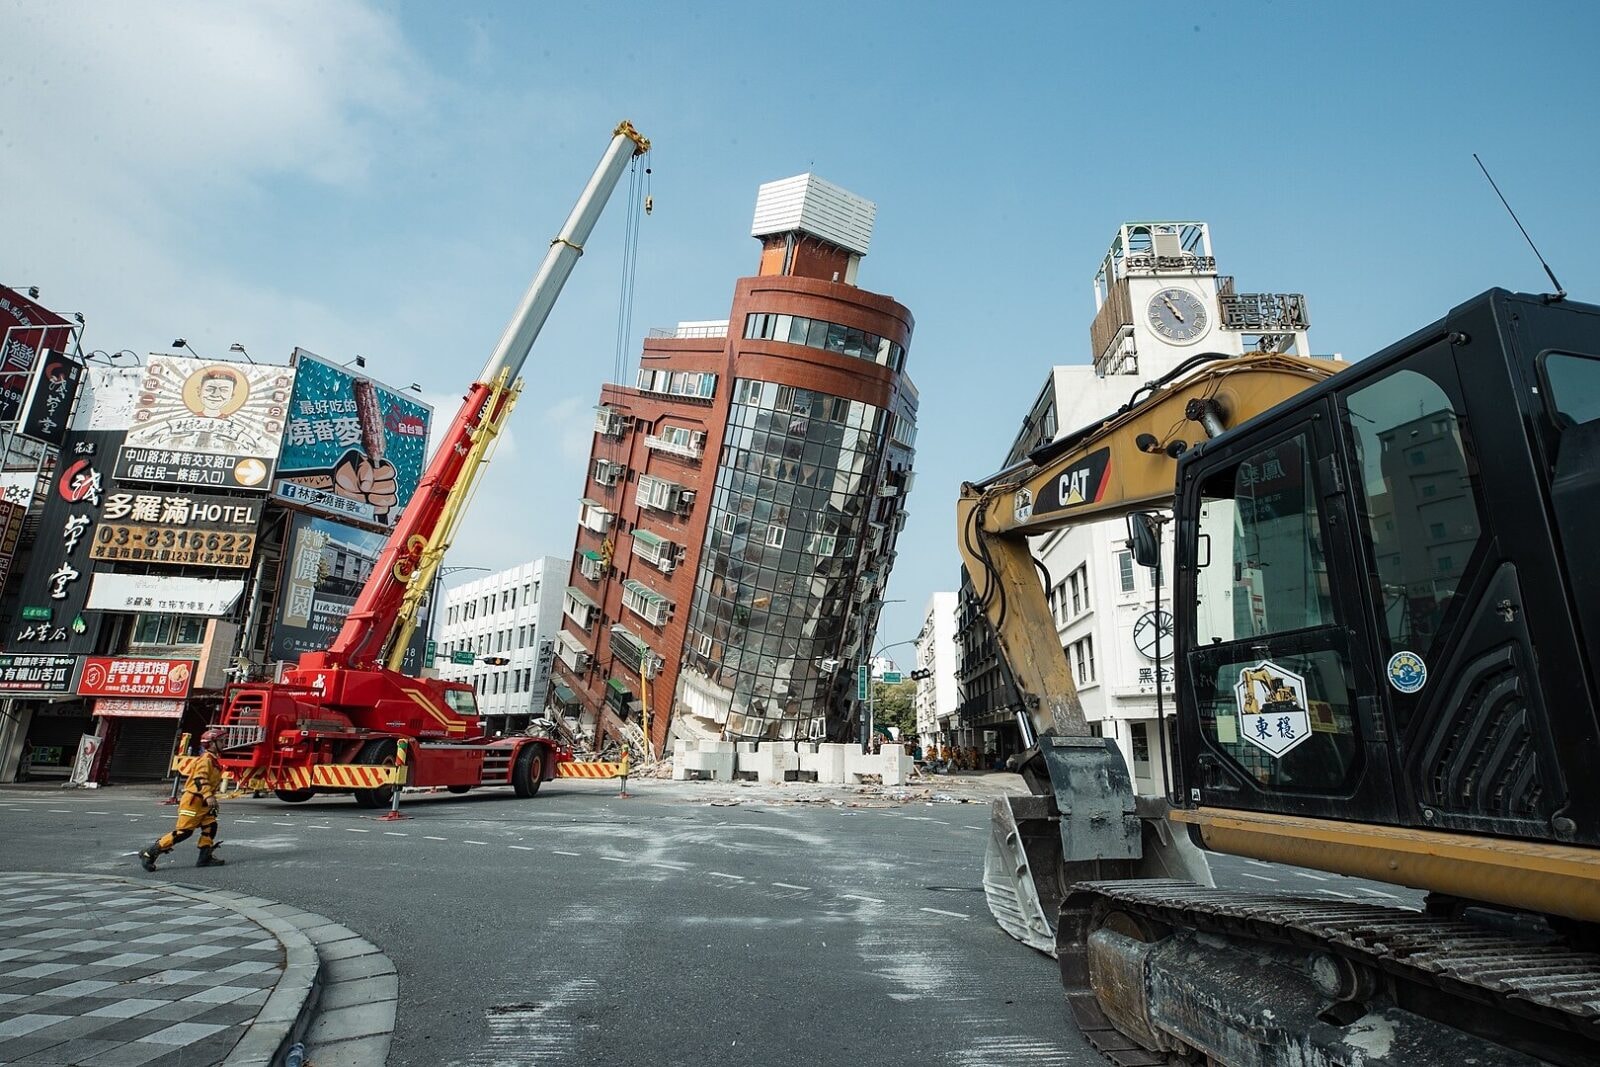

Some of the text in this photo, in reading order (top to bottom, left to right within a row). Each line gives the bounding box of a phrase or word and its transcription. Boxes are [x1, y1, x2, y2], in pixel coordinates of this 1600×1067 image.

[301, 399, 358, 415] 最好吃的
[286, 416, 363, 447] 燒番麥
[127, 465, 226, 485] (原住民一條街入口)
[1058, 467, 1090, 506] CAT
[103, 493, 256, 525] 多羅滿 HOTEL
[99, 525, 252, 553] 03-8316622
[17, 621, 67, 641] 山苦瓜
[4, 667, 68, 682] 有機山苦瓜
[1255, 716, 1296, 740] 東穩
